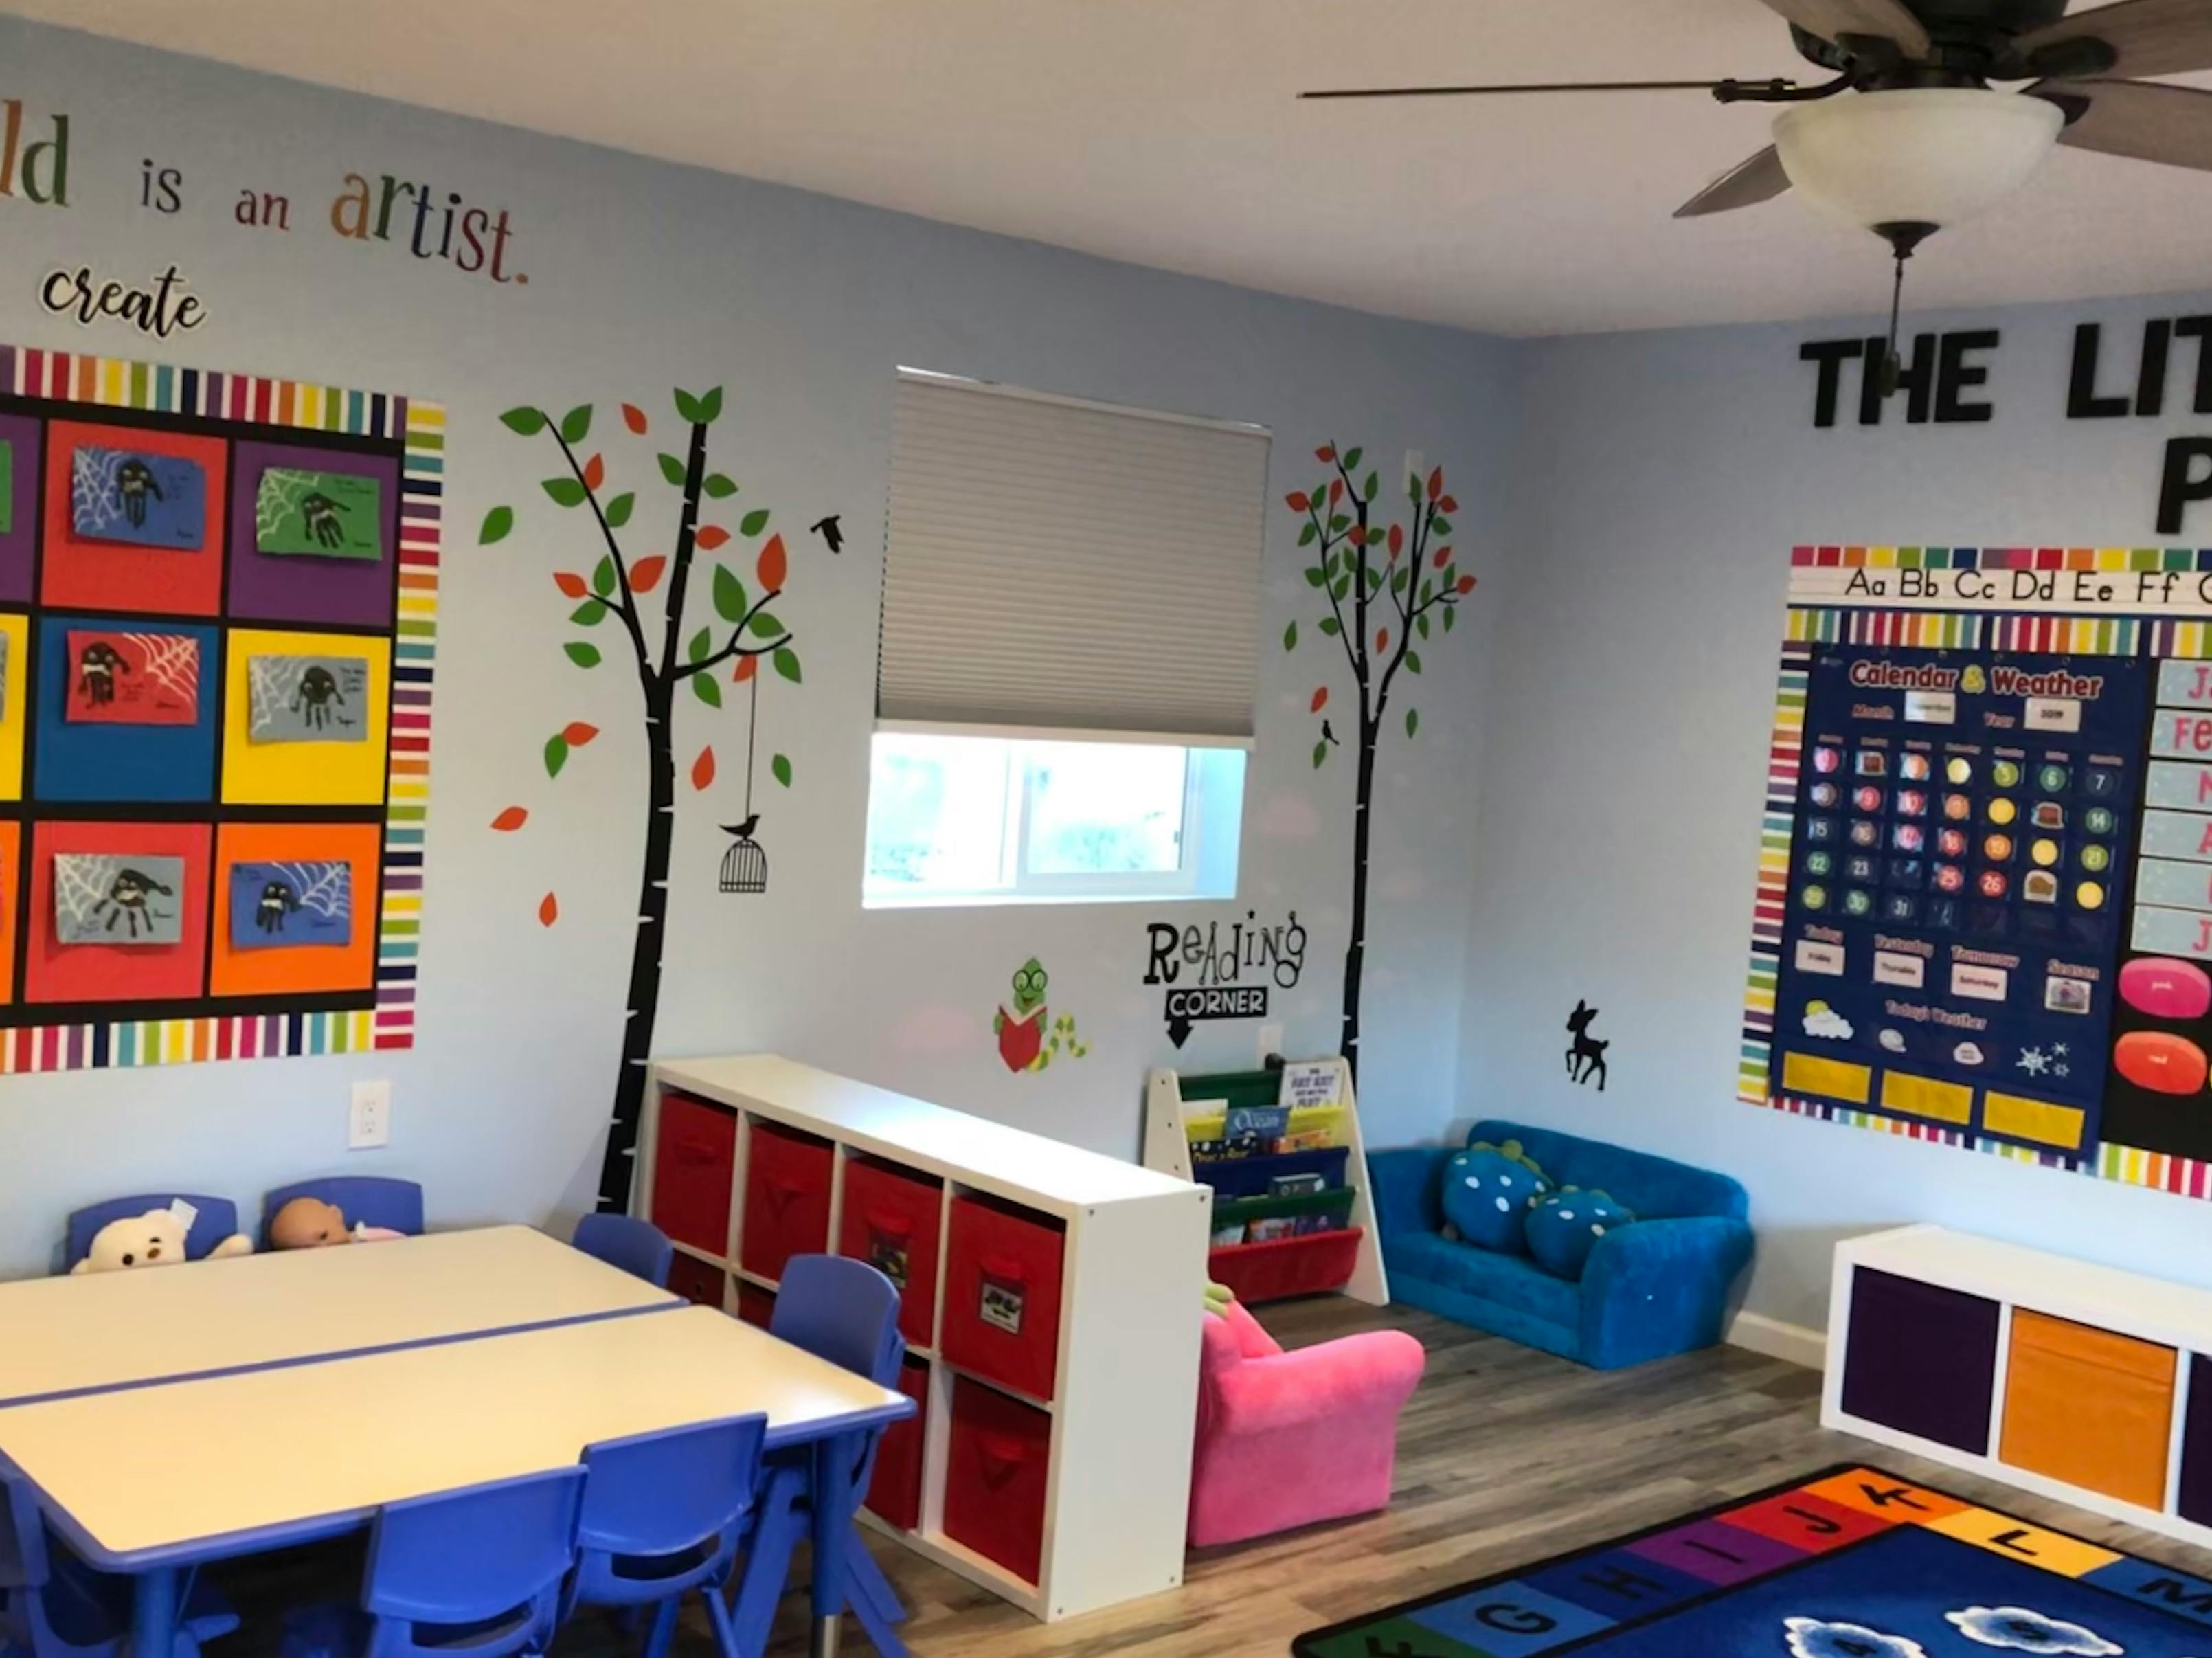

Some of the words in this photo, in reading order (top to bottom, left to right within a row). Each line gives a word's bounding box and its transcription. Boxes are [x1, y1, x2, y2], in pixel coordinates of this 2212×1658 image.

[141, 158, 182, 214] is
[234, 189, 290, 231] an
[330, 173, 529, 283] artist.
[43, 265, 207, 338] create
[1800, 329, 2000, 427] THE
[1844, 567, 1886, 596] Aa
[1899, 568, 1939, 597] Bb
[1954, 570, 1995, 599] Cc
[2011, 570, 2055, 601] Dd
[2073, 571, 2114, 601] Ee
[2136, 572, 2180, 603] Ff
[1849, 659, 1959, 691] Calendar
[1961, 664, 1986, 694] &
[1991, 666, 2103, 699] Weather
[2095, 773, 2107, 791] 7
[1853, 860, 1869, 877] 23
[1169, 992, 1265, 1018] CORNER
[1474, 1602, 1557, 1635] G
[1580, 1566, 1667, 1600] H
[1782, 1505, 1842, 1534] J
[1859, 1483, 1936, 1512] K
[1989, 1528, 2038, 1557] L
